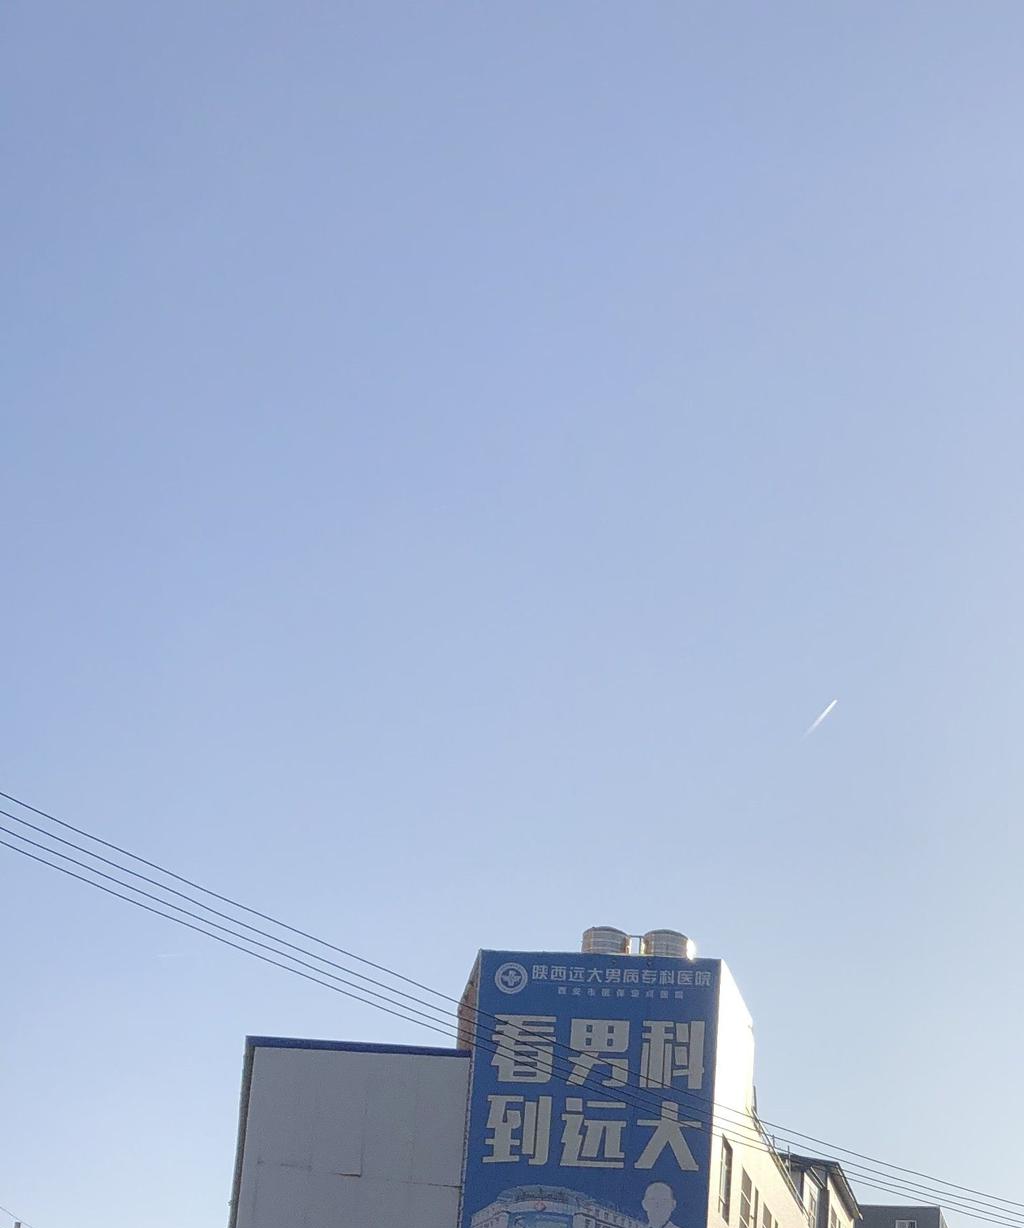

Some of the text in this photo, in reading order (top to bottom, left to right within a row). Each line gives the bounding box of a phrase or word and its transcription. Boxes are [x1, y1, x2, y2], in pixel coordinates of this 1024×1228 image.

[532, 964, 712, 987] 陕西远大男病专科医院
[491, 1014, 705, 1089] 看男科
[482, 1095, 702, 1171] 到远大
